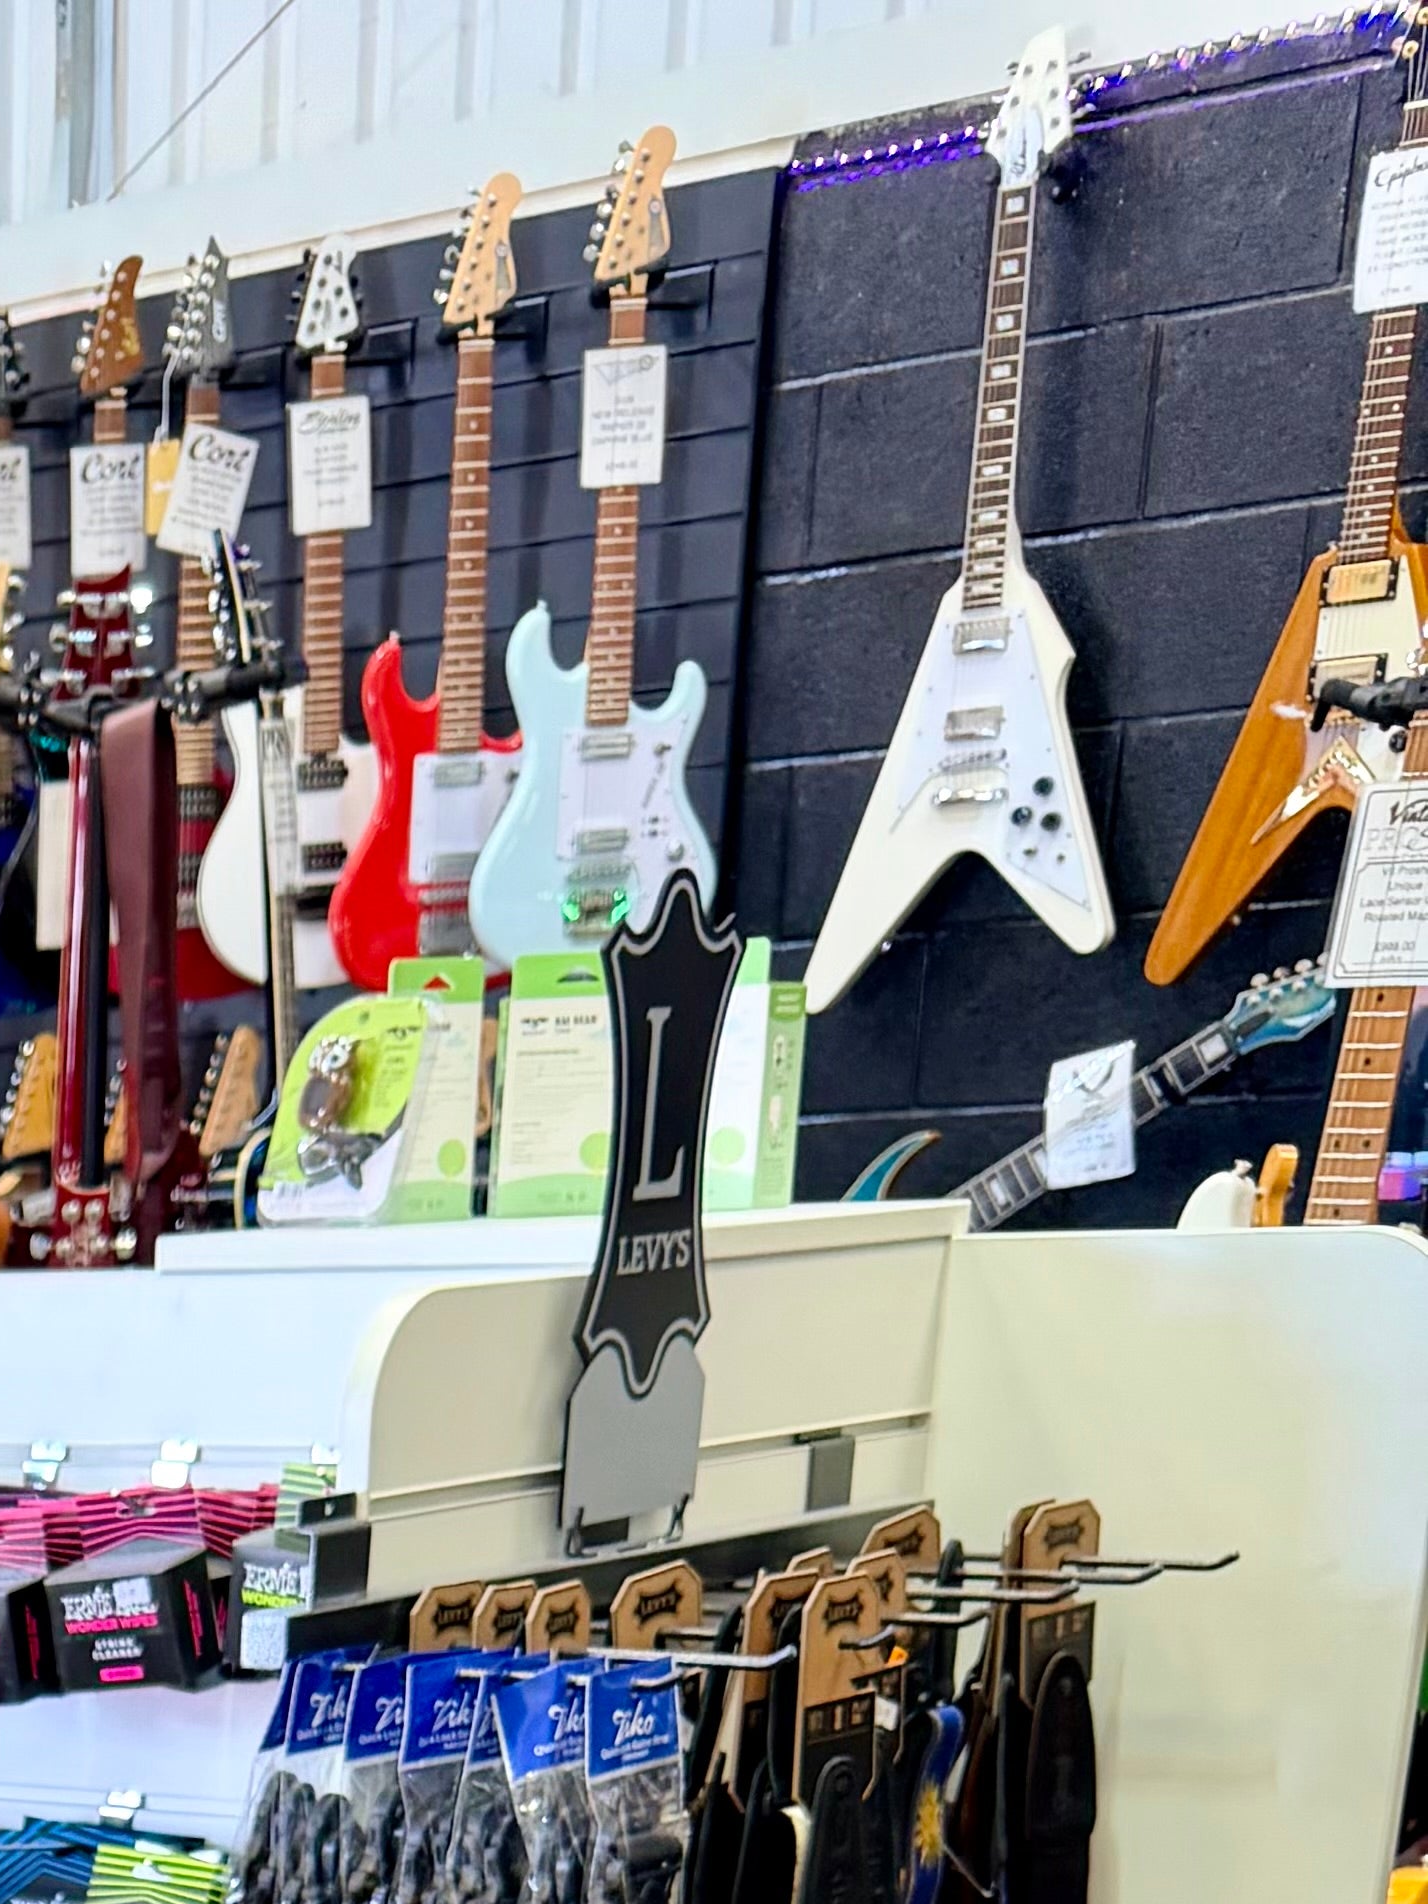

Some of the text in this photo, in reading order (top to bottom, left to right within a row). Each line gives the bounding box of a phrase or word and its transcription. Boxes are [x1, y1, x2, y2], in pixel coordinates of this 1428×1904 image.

[244, 1561, 298, 1596] ERNIE
[60, 1584, 114, 1622] ERNIE
[64, 1612, 159, 1635] WONDER WIPES
